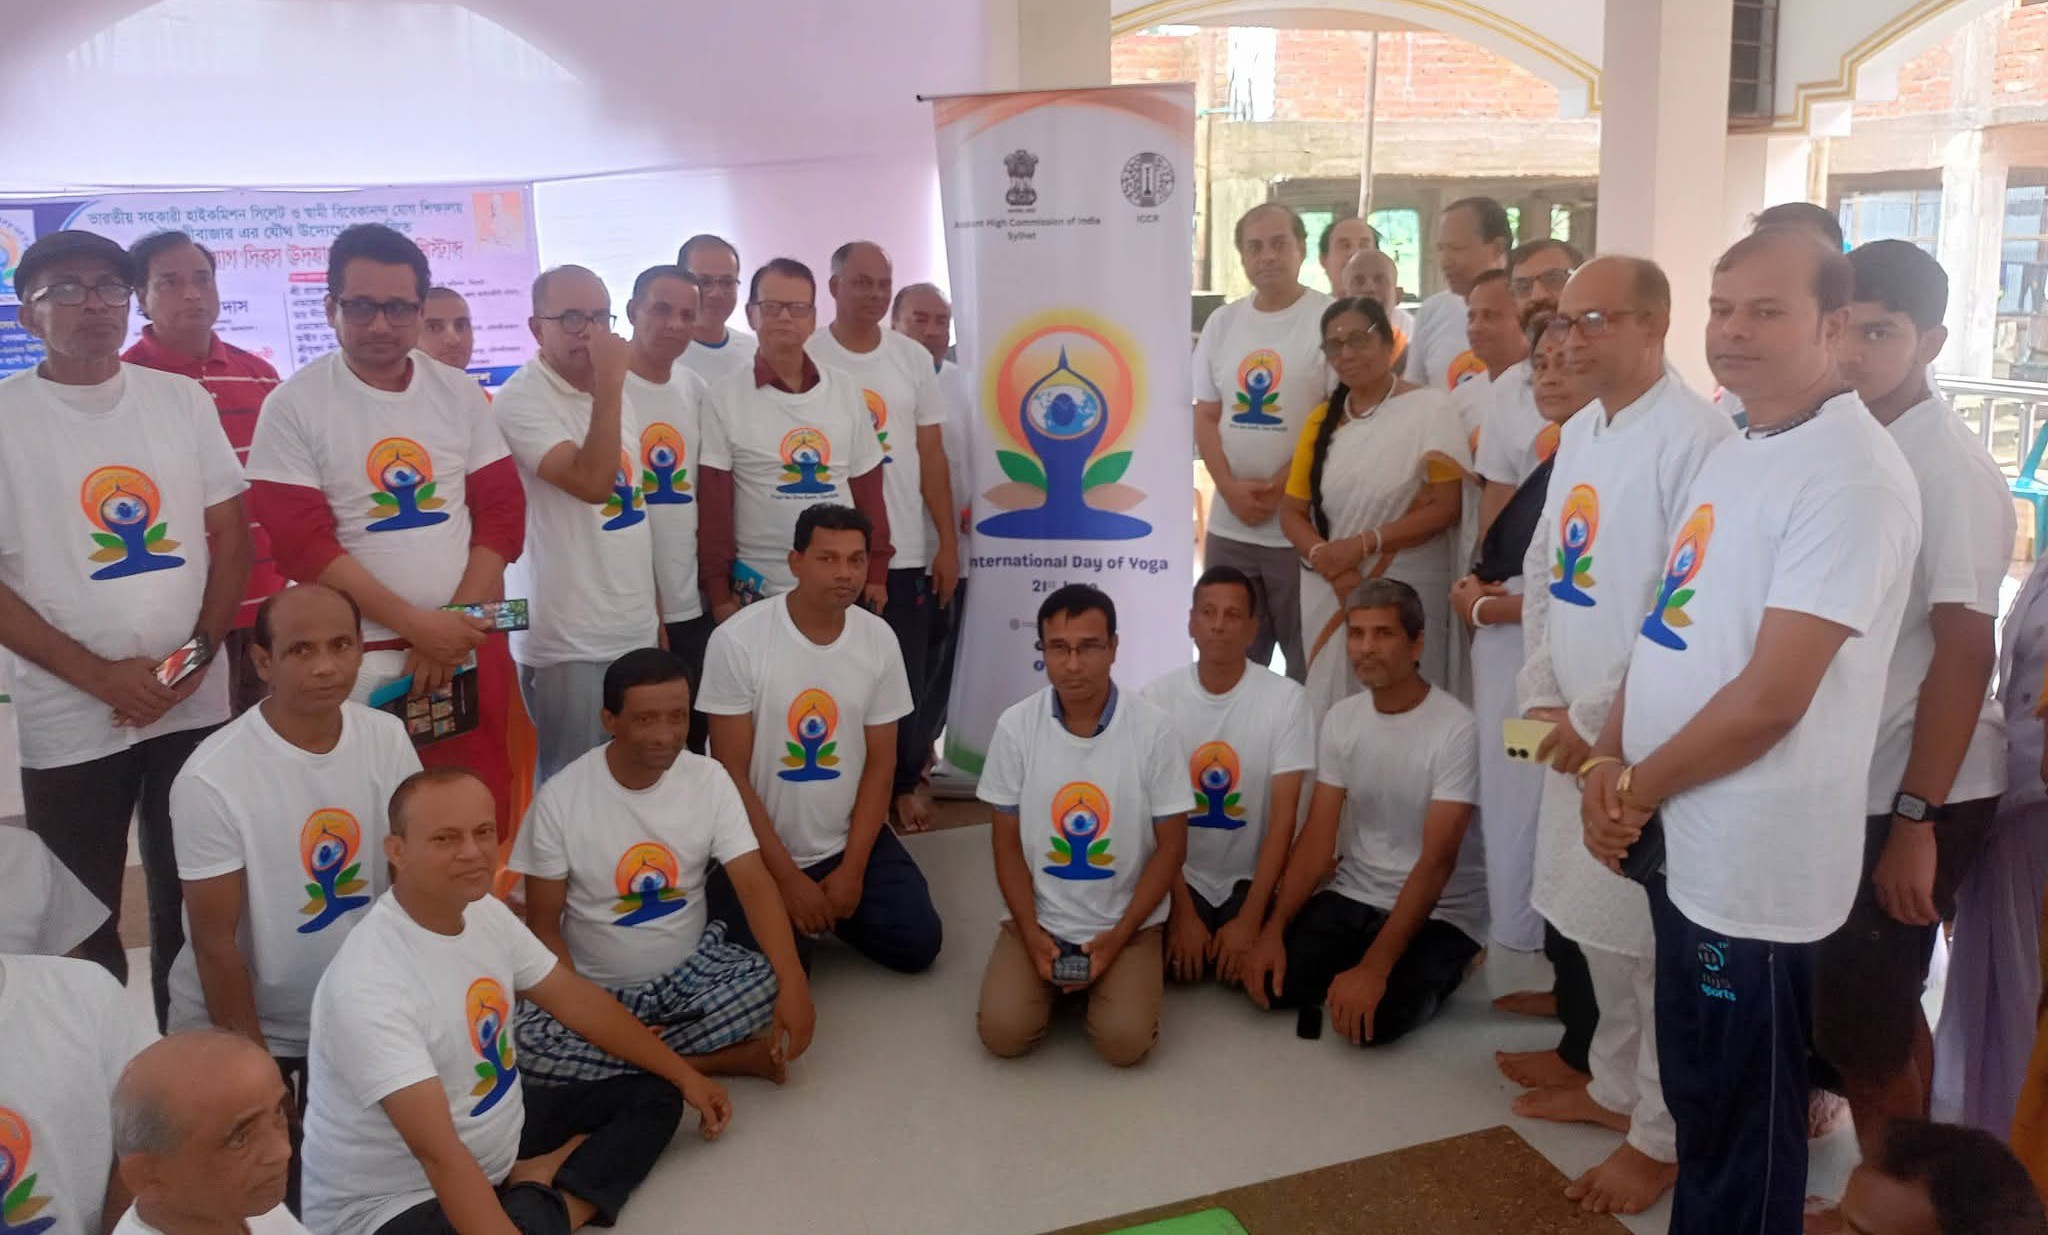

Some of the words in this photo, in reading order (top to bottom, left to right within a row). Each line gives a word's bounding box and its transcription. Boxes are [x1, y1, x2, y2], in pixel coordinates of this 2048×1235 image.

[969, 553, 1067, 569] nternational
[1072, 555, 1102, 572] Day
[1107, 556, 1123, 570] of
[1129, 557, 1169, 574] Yoga
